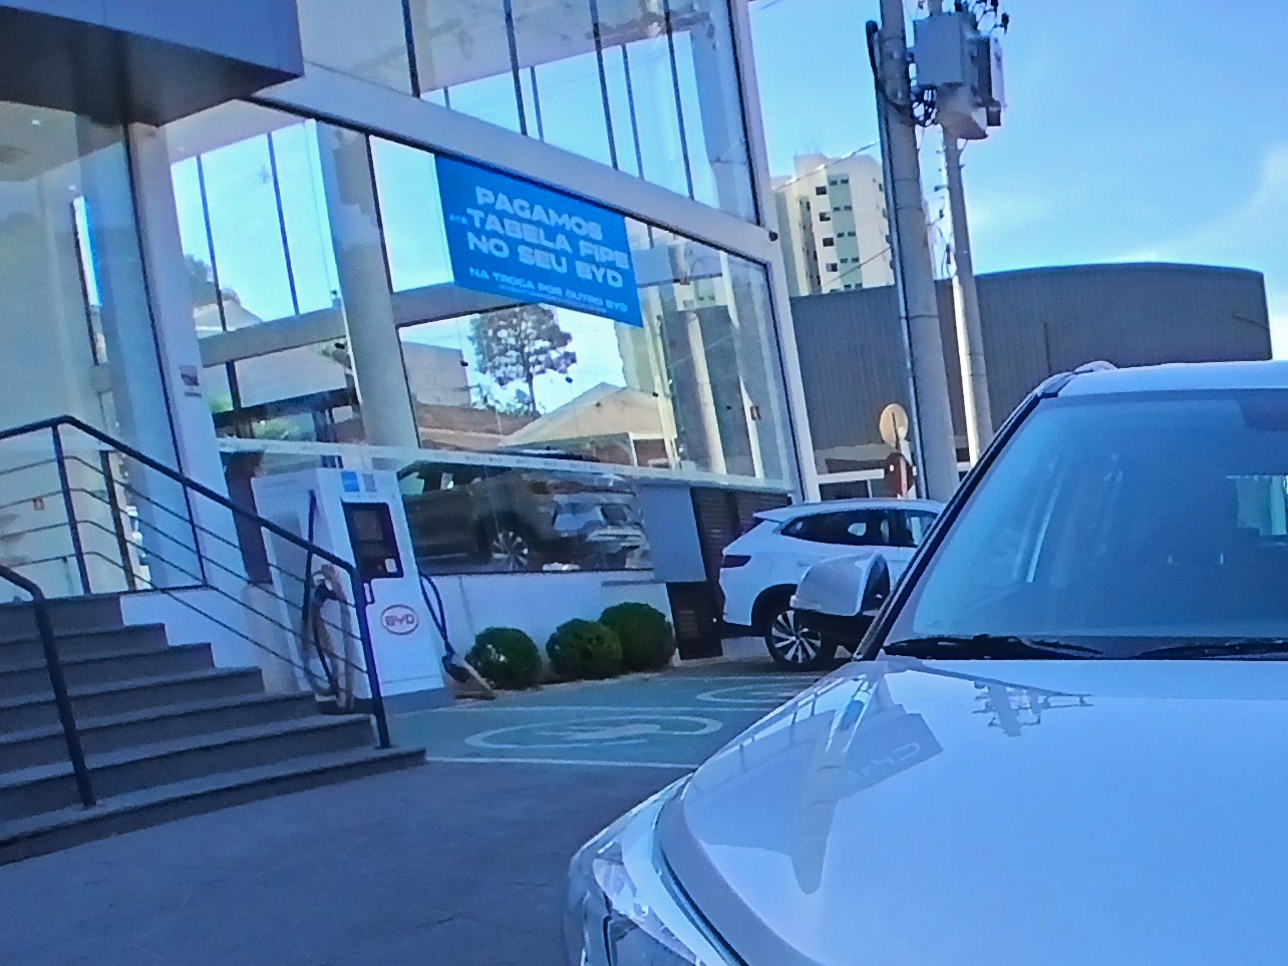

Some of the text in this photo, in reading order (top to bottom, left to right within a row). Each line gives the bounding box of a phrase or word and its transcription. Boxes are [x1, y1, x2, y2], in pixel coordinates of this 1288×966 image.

[466, 207, 629, 270] TABELA FIPE
[475, 186, 603, 240] PAGAMOS
[467, 232, 623, 288] NO SEU BYD
[469, 267, 490, 280] NA
[492, 272, 535, 290] TROCA
[538, 282, 563, 297] POR
[565, 289, 604, 306] OUTRO
[605, 299, 628, 312] BYD
[385, 614, 415, 626] BYD
